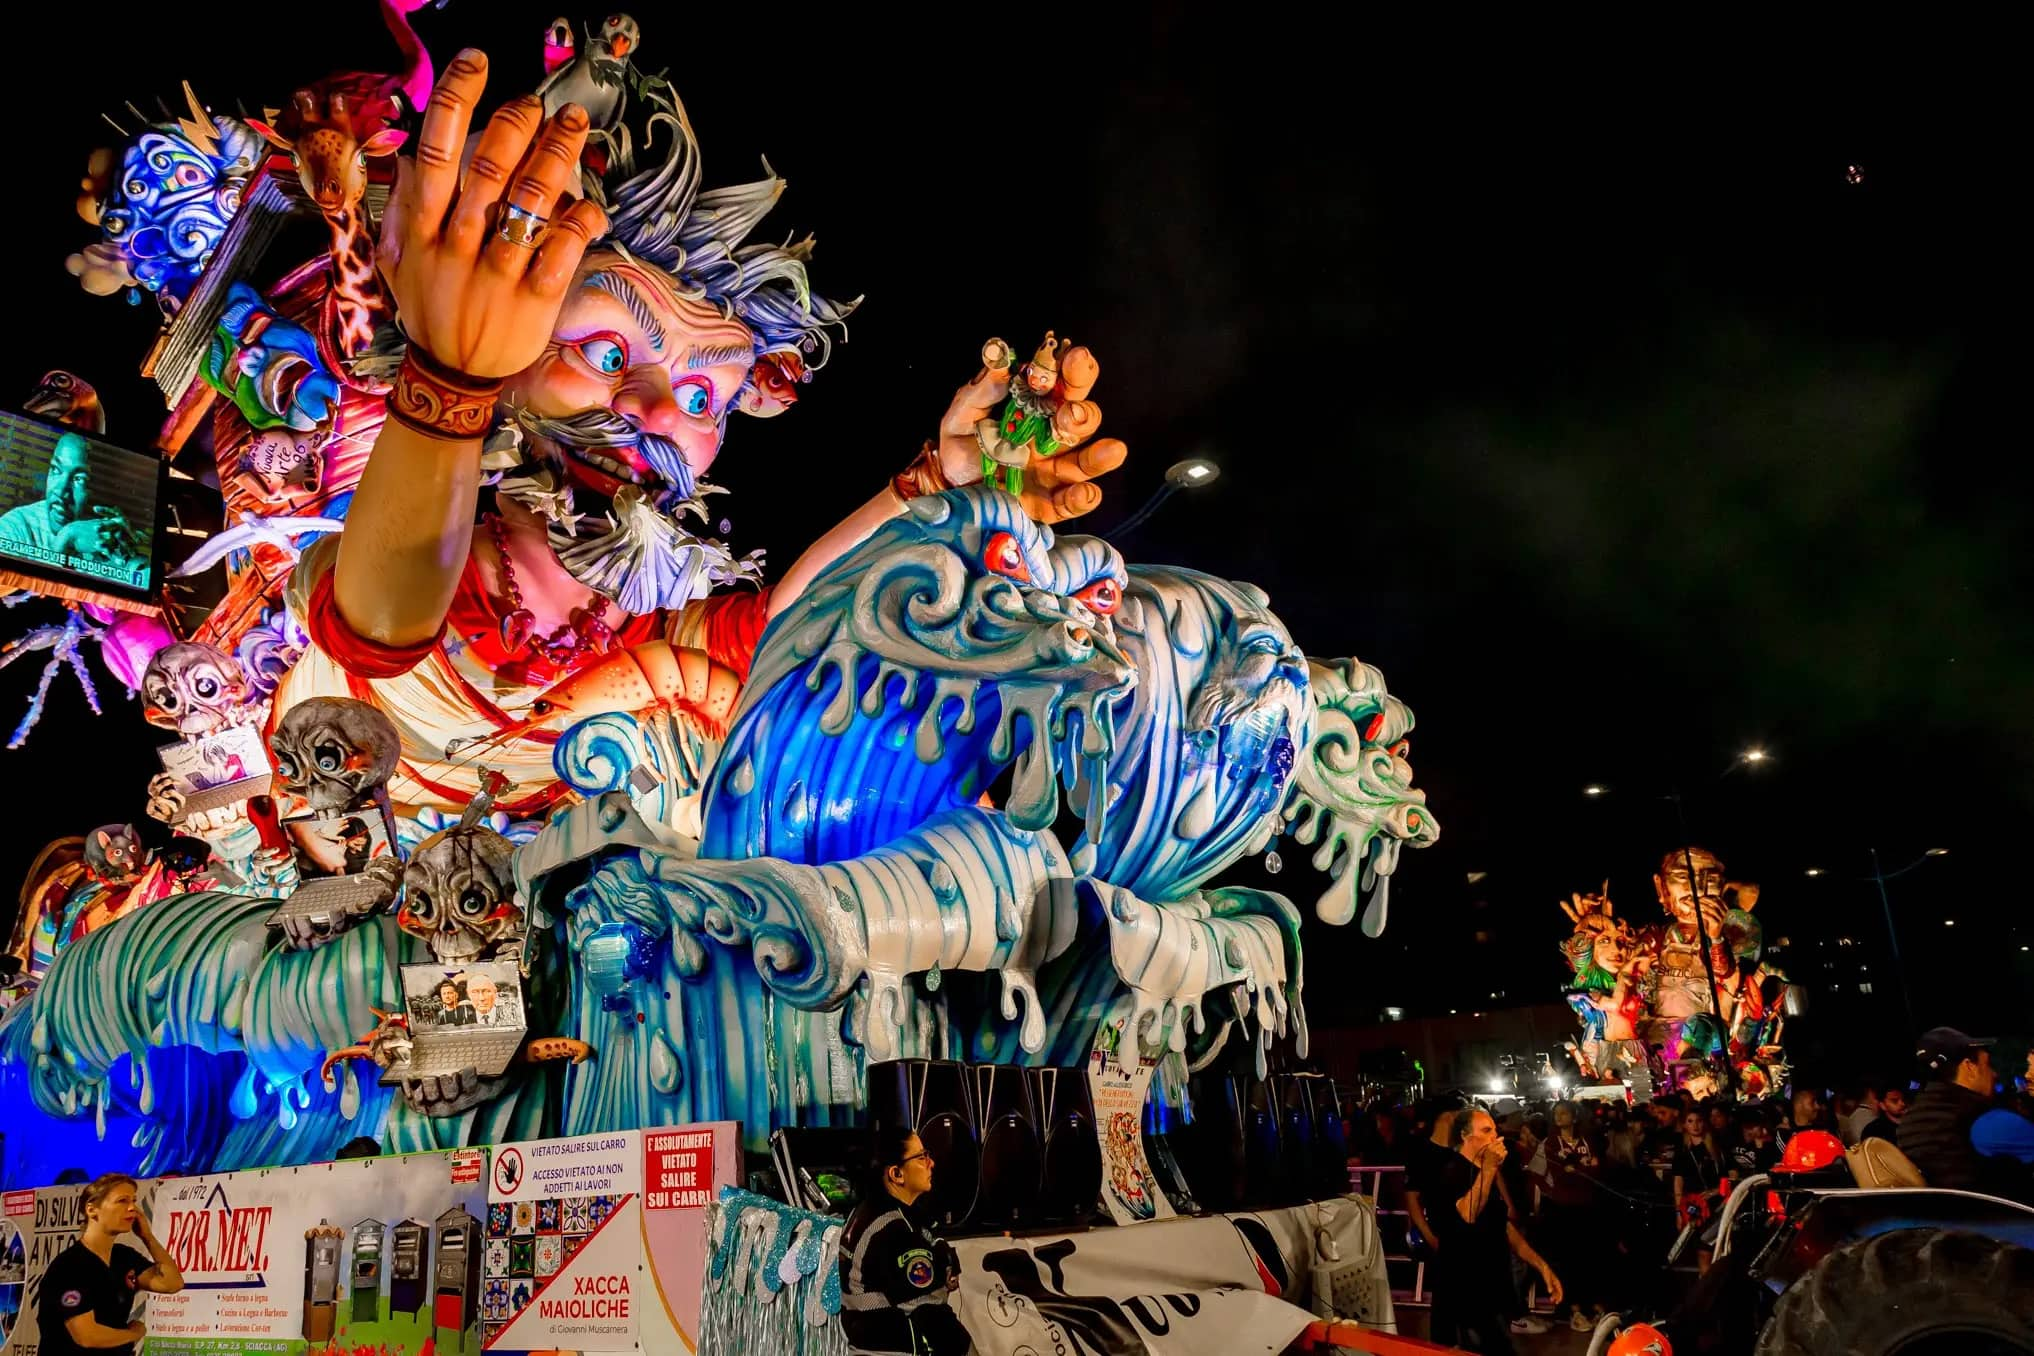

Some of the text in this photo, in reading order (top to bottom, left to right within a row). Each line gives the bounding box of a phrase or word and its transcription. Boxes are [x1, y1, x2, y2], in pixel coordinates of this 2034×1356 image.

[292, 444, 306, 464] 96
[68, 555, 130, 581] PRODUCTION
[531, 1138, 626, 1157] VIETATO SALIRE SUL CARRO
[654, 1133, 712, 1151] ASSOLUTAMENTE
[661, 1153, 697, 1169] VIETATO
[532, 1163, 623, 1180] ACCESSO VIETATO AI NON
[661, 1172, 697, 1188] SALIRE
[190, 1185, 207, 1200] 1972
[543, 1178, 611, 1193] ADDETTI AI LAVORI
[647, 1190, 711, 1207] SUI CARRI
[35, 1198, 48, 1228] DI
[574, 1275, 630, 1296] XACCA
[540, 1299, 629, 1319] MAIOLICHE
[549, 1324, 557, 1334] di
[557, 1324, 587, 1334] Giovanni
